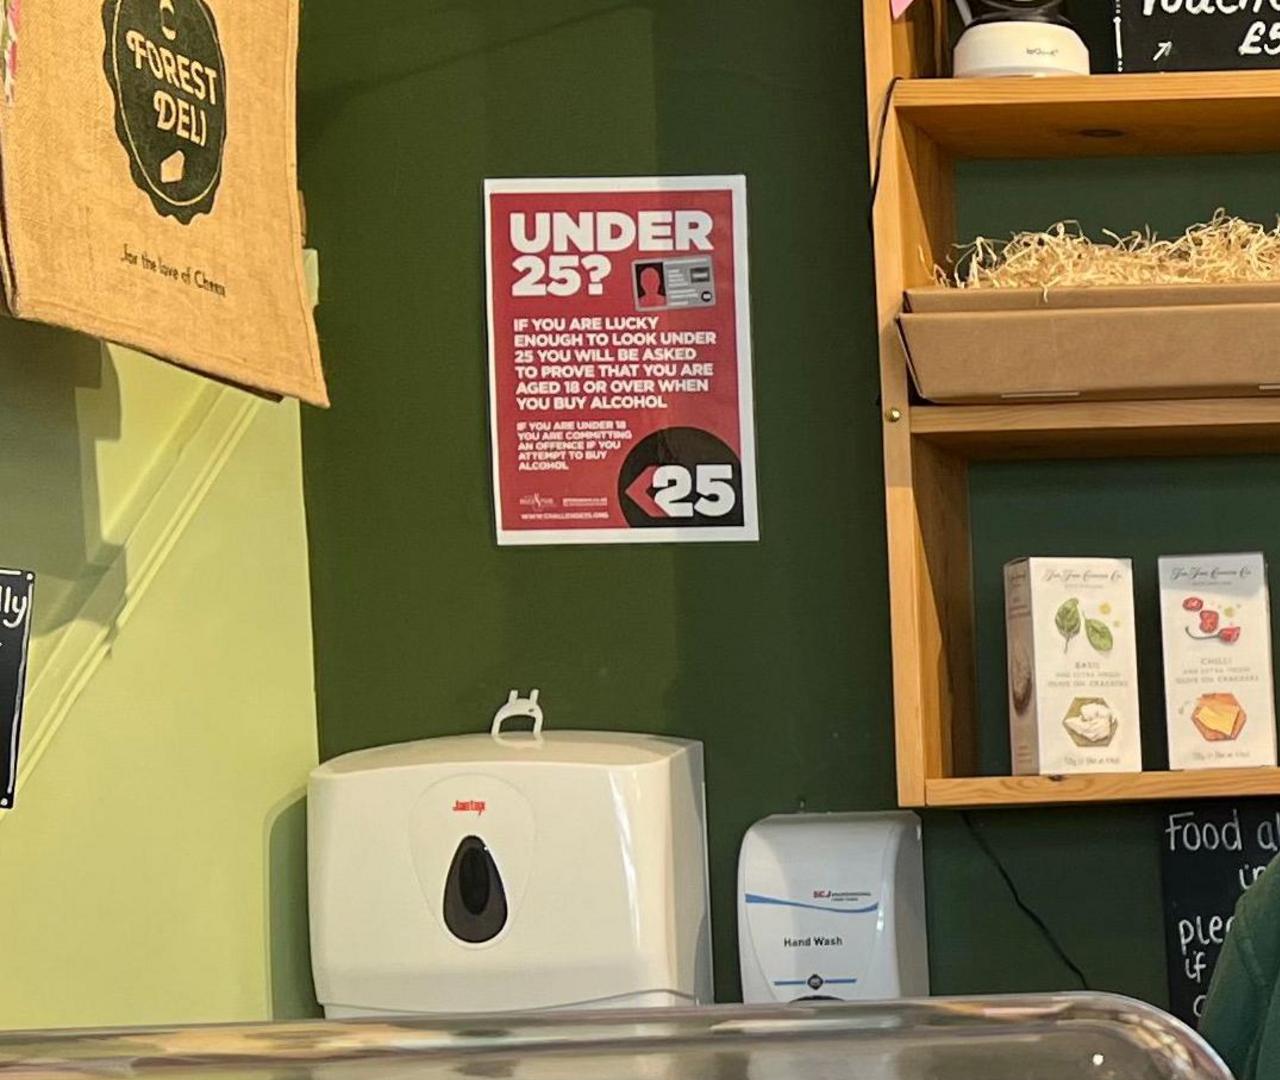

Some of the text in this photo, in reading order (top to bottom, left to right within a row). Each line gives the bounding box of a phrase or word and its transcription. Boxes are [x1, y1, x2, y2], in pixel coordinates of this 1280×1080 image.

[126, 30, 218, 106] FOREST
[153, 90, 206, 147] DELI
[509, 210, 714, 254] UNDER
[511, 254, 612, 297] 25?
[513, 316, 659, 332] IF YOU ARE LUCKY
[514, 331, 716, 347] ENOUGH TO LOOK UNDER
[514, 347, 697, 363] 25 YOU WILL BE ASKED
[515, 363, 714, 379] TO PROVE THAT YOU ARE
[515, 379, 709, 395] AGED 18 OR OVER WHEN
[516, 395, 668, 410] YOU BUY ALCOHOL
[529, 421, 551, 431] YOU
[553, 421, 575, 430] ARE
[576, 420, 614, 430] UNDER
[517, 430, 633, 441] YOU ARE COMMITTING
[518, 441, 533, 451] AN
[535, 441, 585, 451] OFFENCE
[598, 440, 621, 449] YOU
[518, 450, 607, 461] ATTEMPT TO BUY
[518, 461, 569, 471] ALCOHOL
[1165, 809, 1242, 851] Food
[784, 936, 842, 947] Hand Wash
[1185, 952, 1206, 983] if
